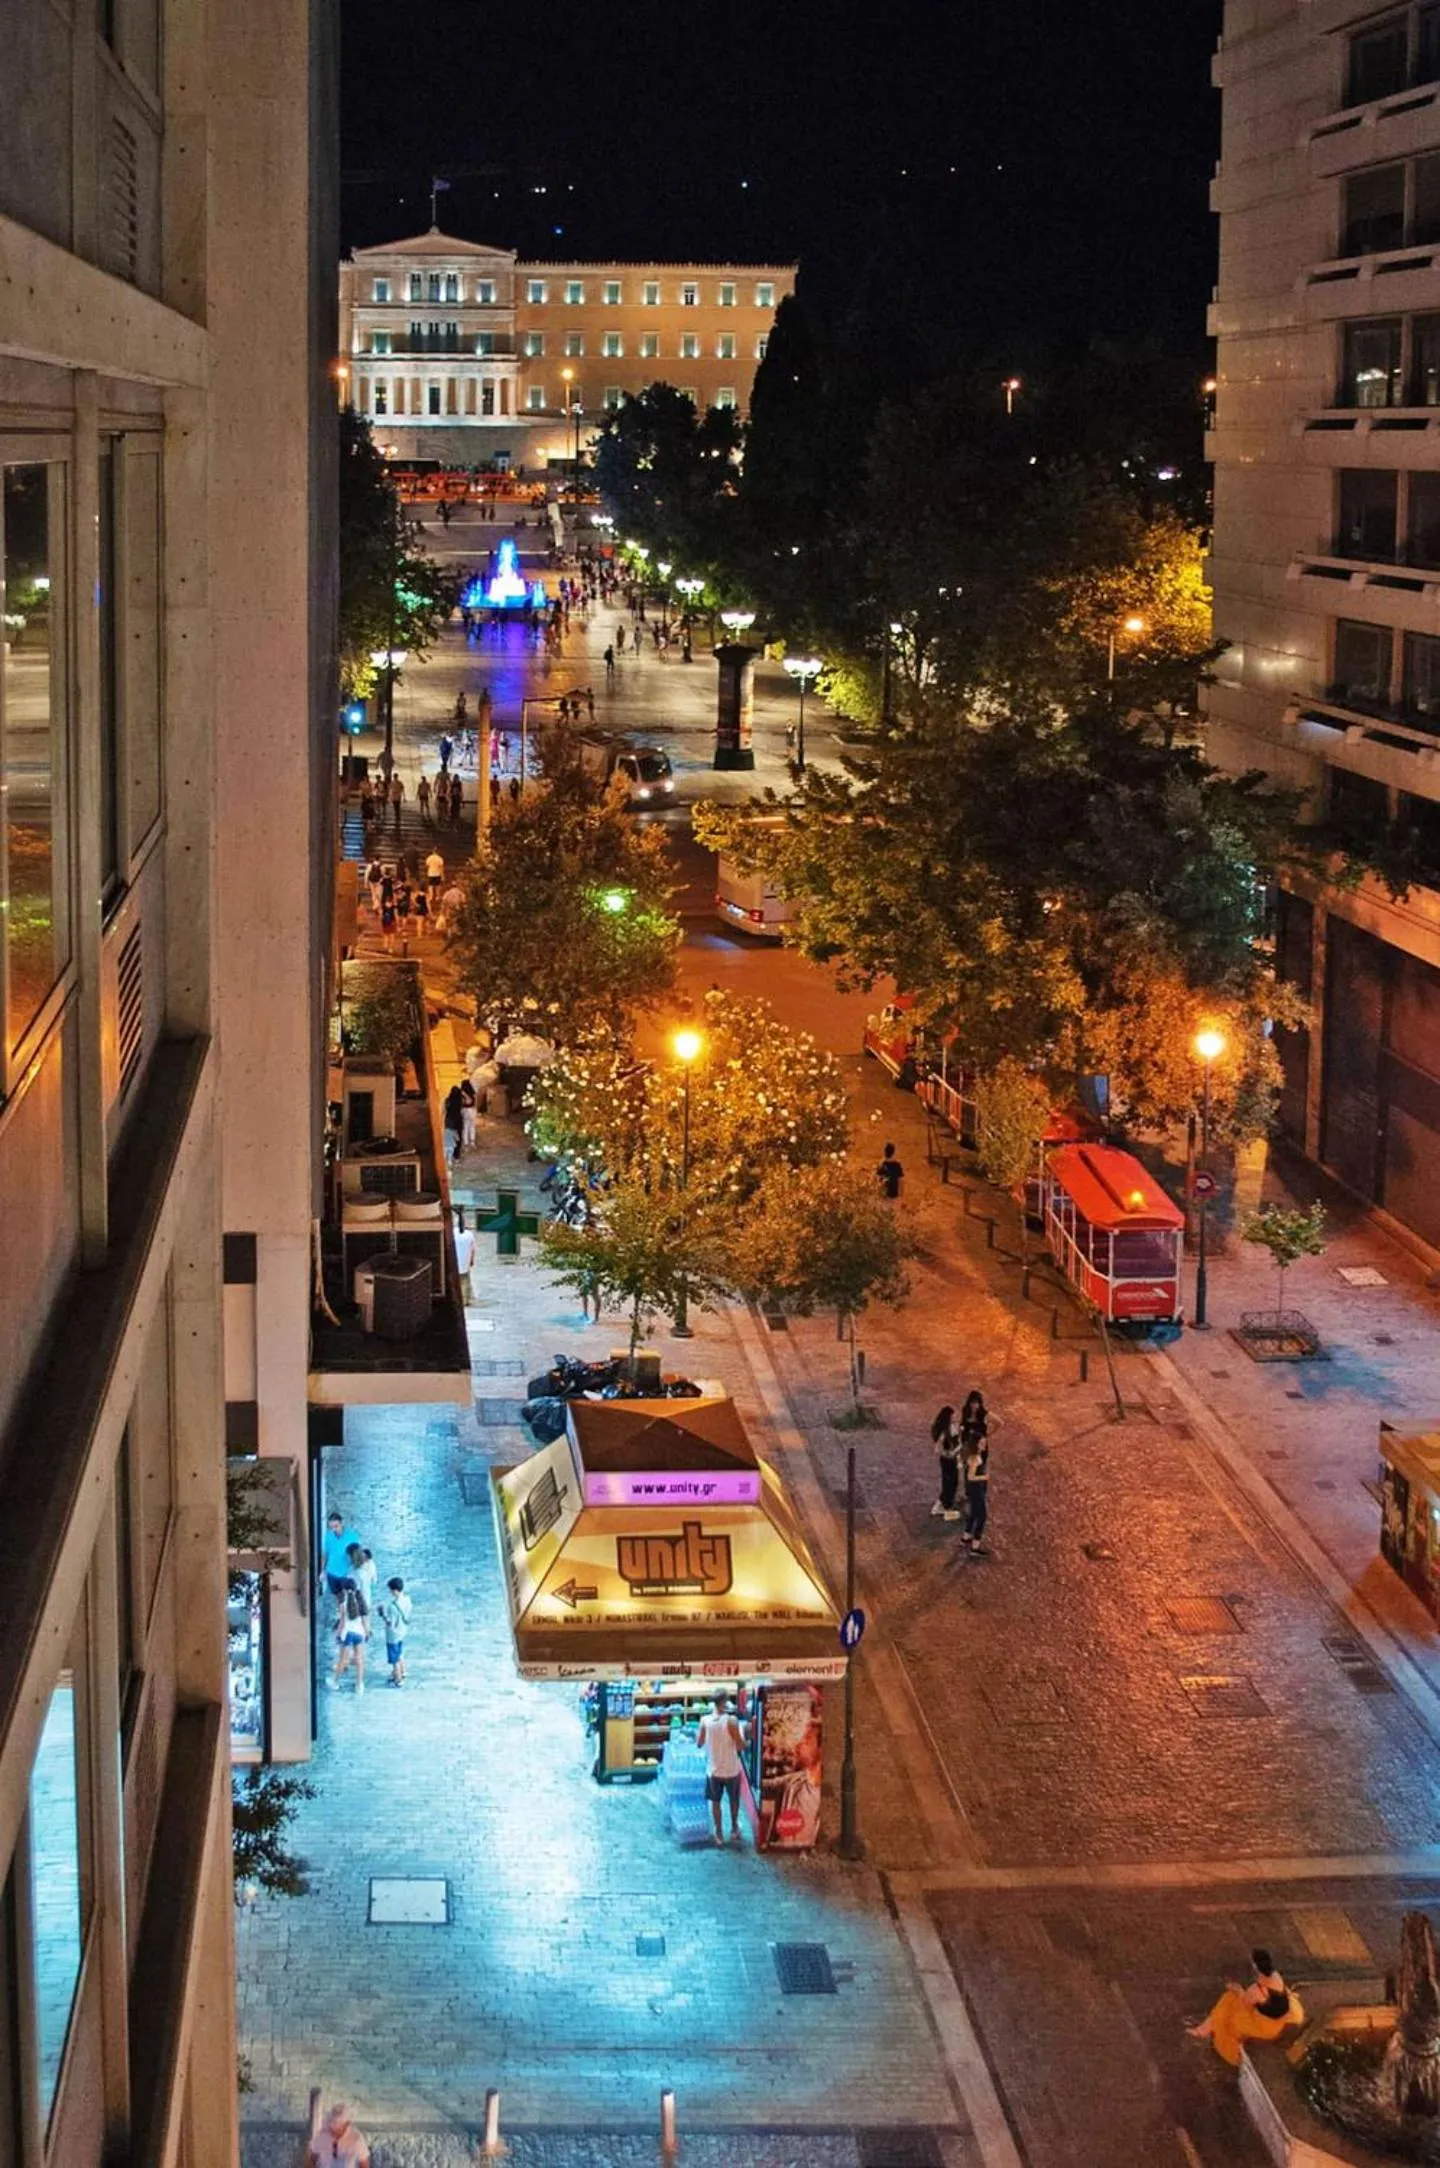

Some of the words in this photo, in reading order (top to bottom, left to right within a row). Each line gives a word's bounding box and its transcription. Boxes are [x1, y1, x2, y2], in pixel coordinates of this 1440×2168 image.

[631, 1481, 717, 1496] www.unity.gr
[616, 1521, 733, 1596] unity
[785, 1662, 833, 1675] element
